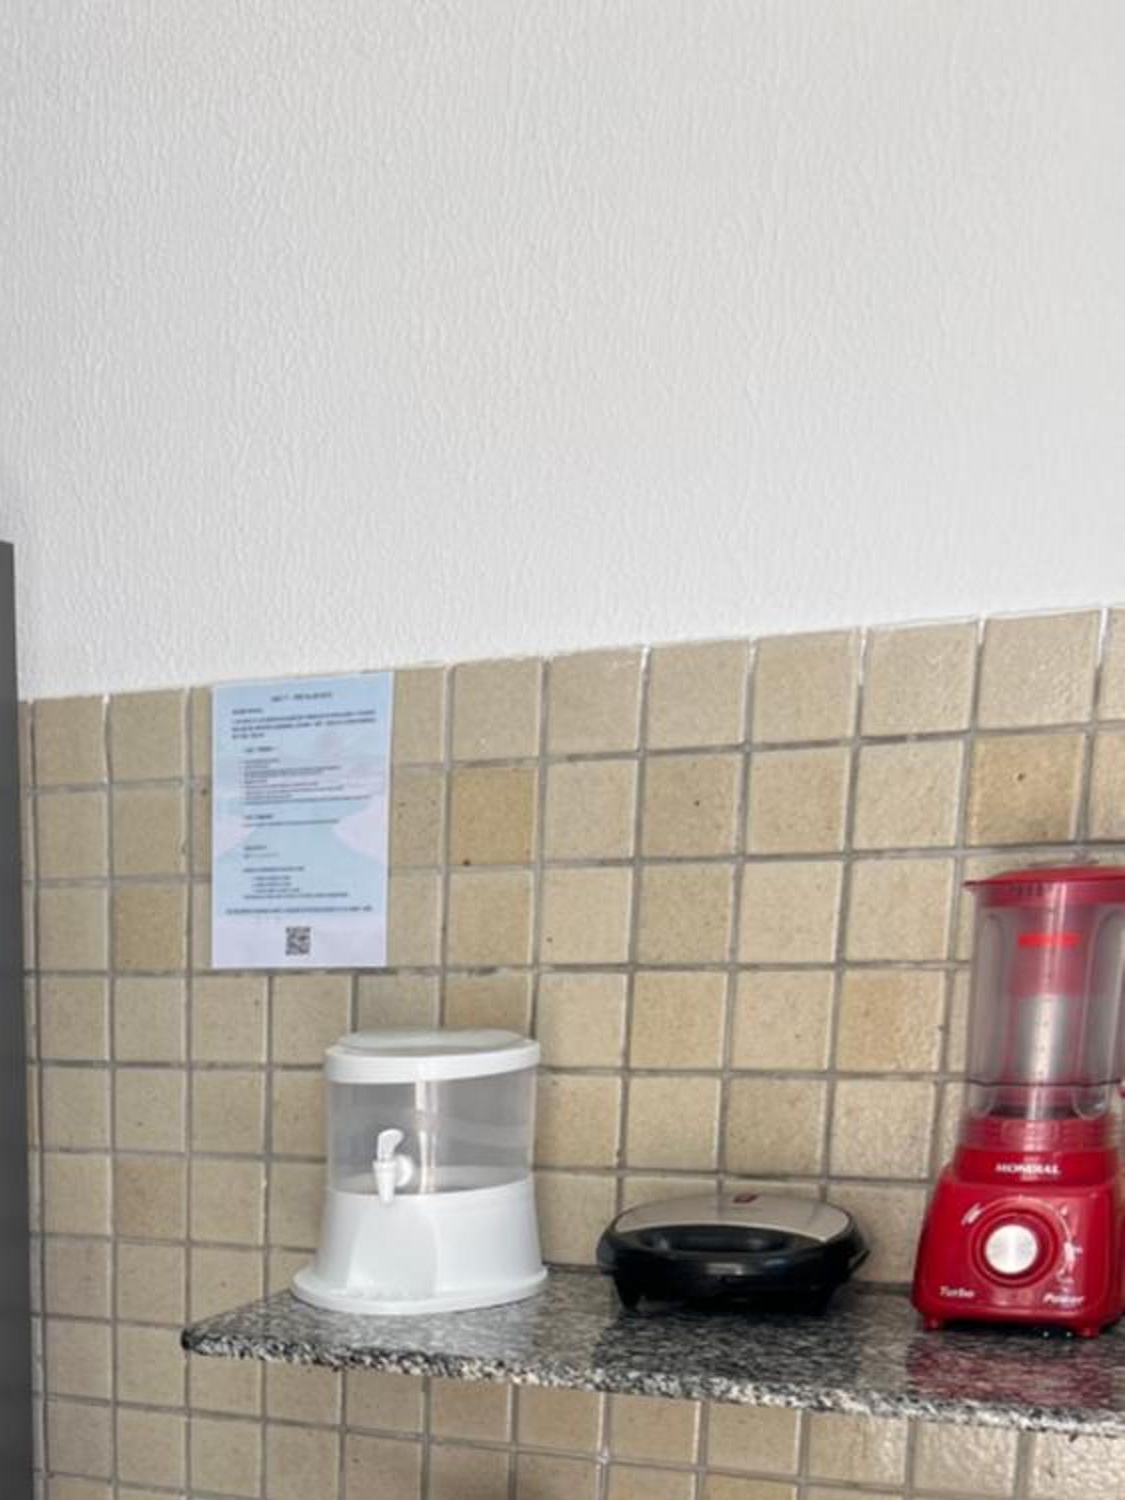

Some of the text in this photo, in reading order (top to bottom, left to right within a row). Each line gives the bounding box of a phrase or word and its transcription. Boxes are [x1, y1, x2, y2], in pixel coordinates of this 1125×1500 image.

[995, 1162, 1062, 1176] MONDIAL
[939, 1285, 975, 1298] Turbo
[1042, 1292, 1084, 1306] Power
